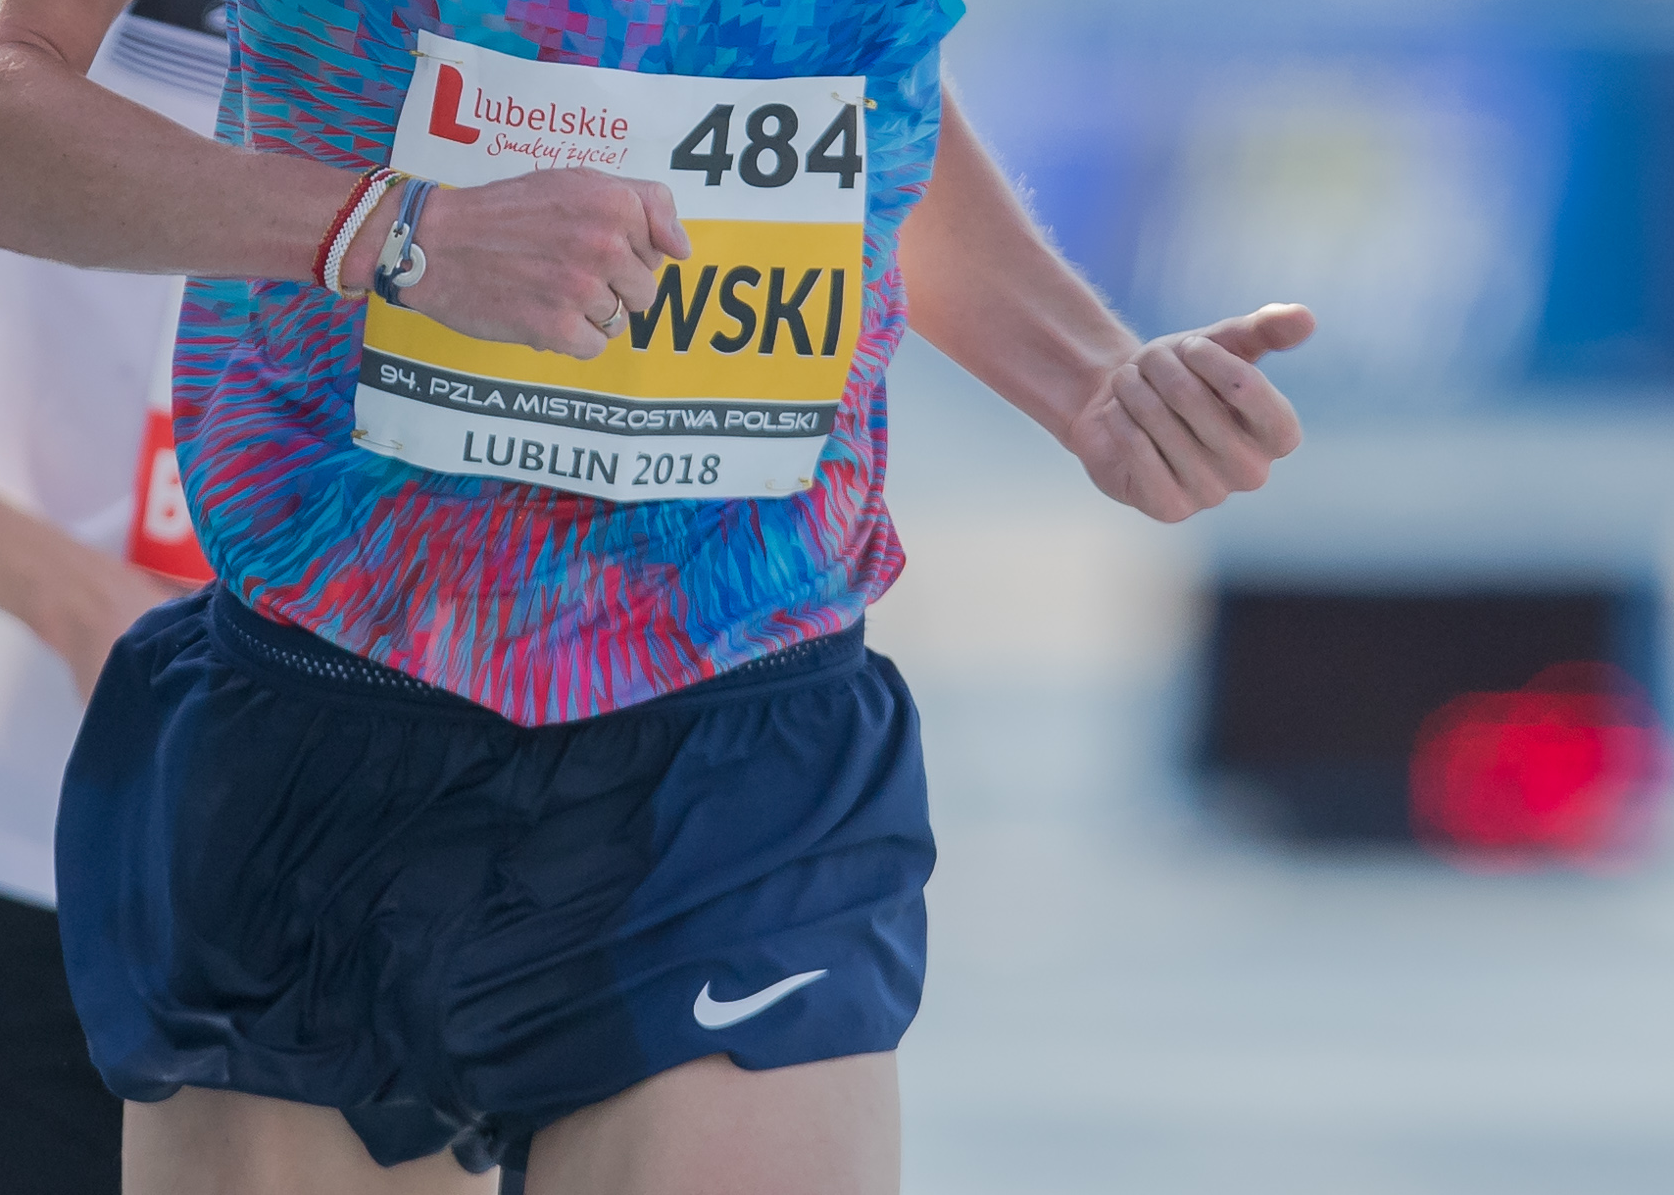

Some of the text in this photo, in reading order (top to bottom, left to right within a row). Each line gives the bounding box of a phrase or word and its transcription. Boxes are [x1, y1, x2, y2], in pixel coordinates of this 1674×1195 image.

[669, 103, 863, 189] 484
[628, 263, 846, 358] WSKI
[379, 363, 821, 432] 94. PZLA MISTRZOSTWA POLSKI
[461, 430, 721, 487] LUBLIN 2018
